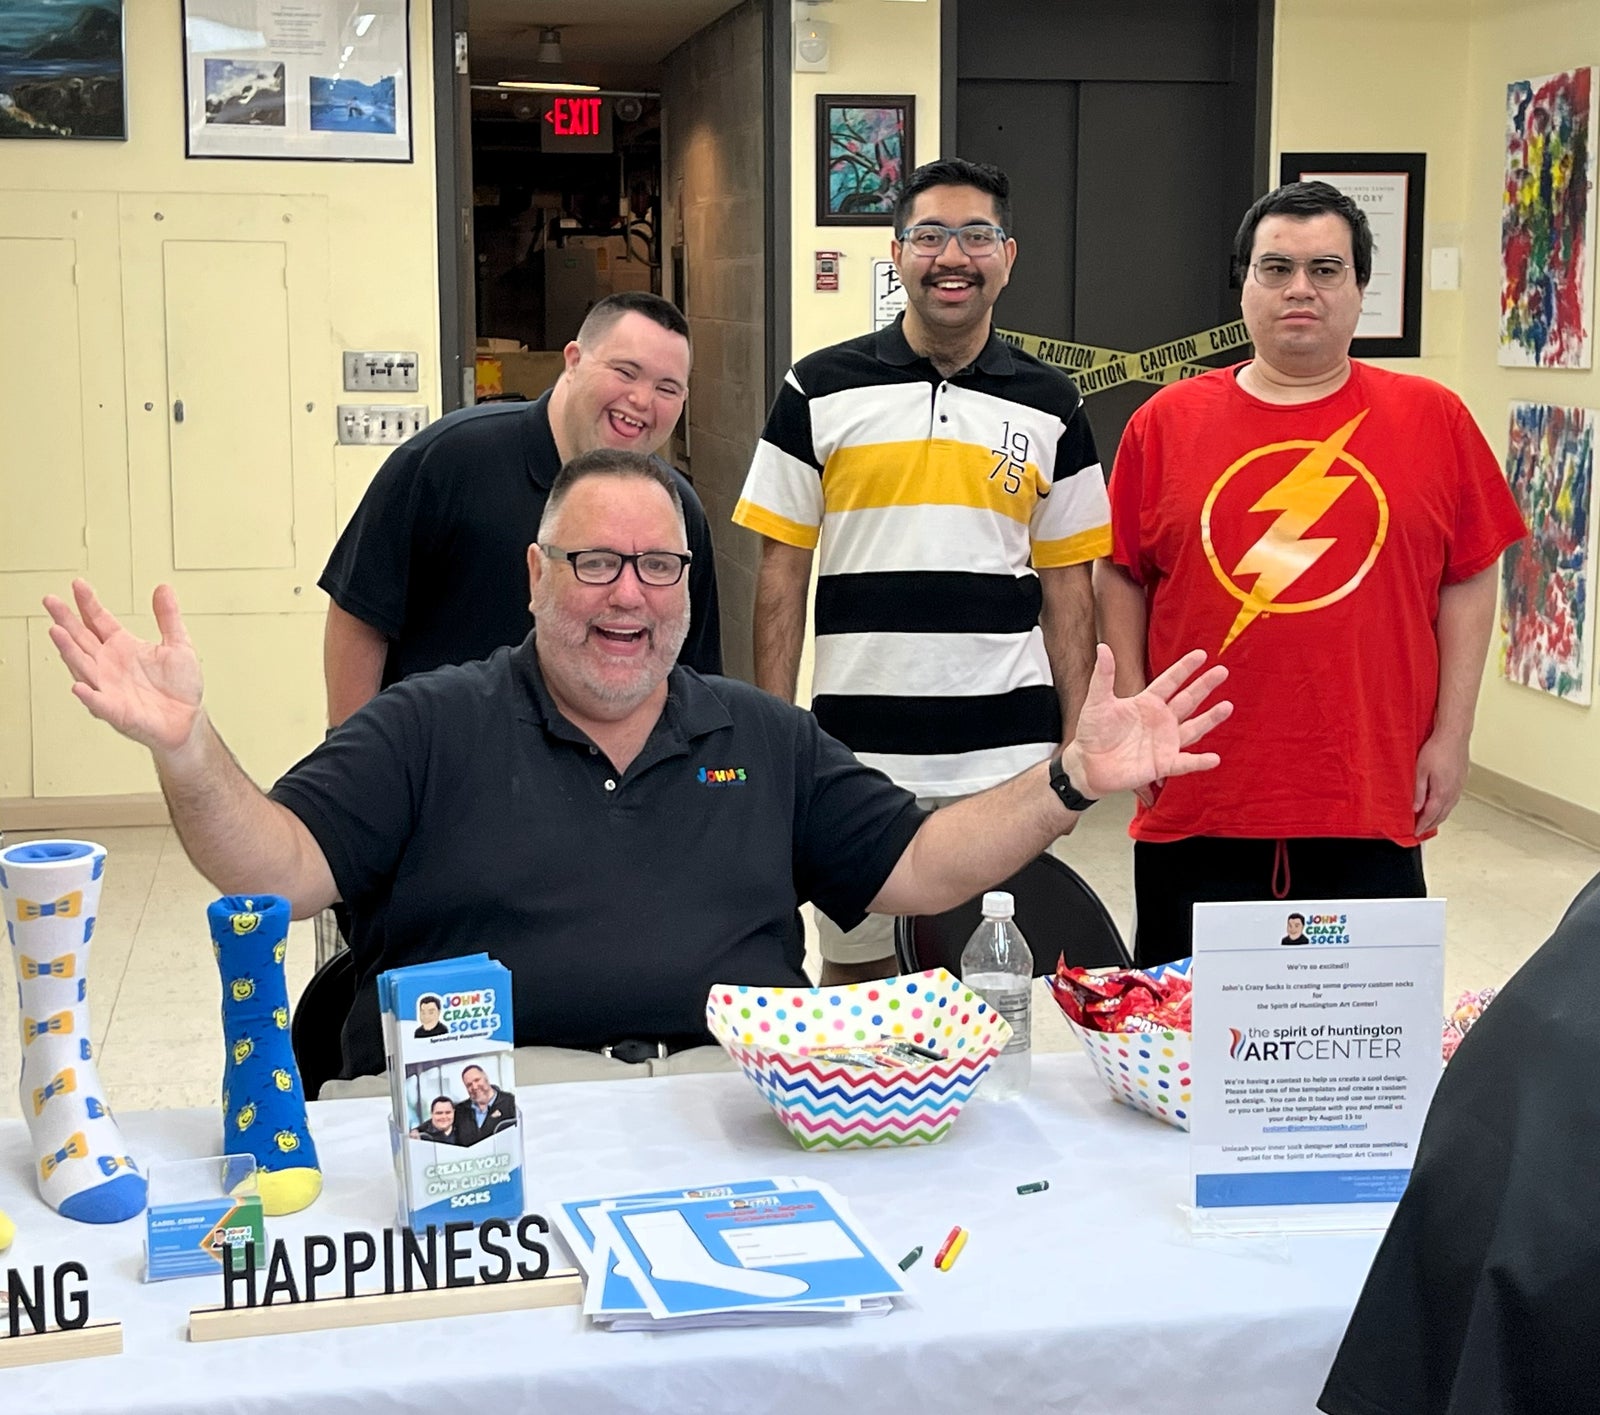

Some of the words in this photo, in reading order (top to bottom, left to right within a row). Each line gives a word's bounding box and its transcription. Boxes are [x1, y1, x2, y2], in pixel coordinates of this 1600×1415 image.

[554, 97, 602, 135] EXIT
[1037, 340, 1096, 369] CAUTION
[1140, 338, 1198, 373] CAUTION
[1209, 322, 1249, 350] CAUTI
[1001, 421, 1029, 463] 19
[990, 449, 1025, 495] 75
[1305, 914, 1347, 925] JOHNS
[1305, 925, 1346, 935] CRAZY
[1310, 934, 1350, 944] SOCKS
[1245, 984, 1264, 992] Crazy
[443, 992, 492, 1009] JOHNS
[1270, 1002, 1288, 1010] Spirit
[1298, 1001, 1338, 1009] Huntington
[443, 1006, 491, 1022] CRAZY
[450, 1016, 498, 1033] SOCKS
[1248, 1026, 1270, 1039] the
[1273, 1025, 1307, 1040] spirit
[1310, 1025, 1326, 1038] of
[1328, 1024, 1403, 1038] huntington
[1246, 1078, 1269, 1086] having
[1315, 1095, 1334, 1103] today
[1319, 1114, 1343, 1122] August
[1372, 1141, 1408, 1149] something
[1236, 1154, 1260, 1162] special
[1314, 1152, 1353, 1160] Huntington
[426, 1160, 473, 1177] CREATE
[476, 1154, 510, 1169] YOUR
[428, 1181, 458, 1194] OWN
[461, 1172, 511, 1188] CUSTOM
[450, 1190, 491, 1208] SOCKS
[222, 1214, 550, 1310] HAPPINESS
